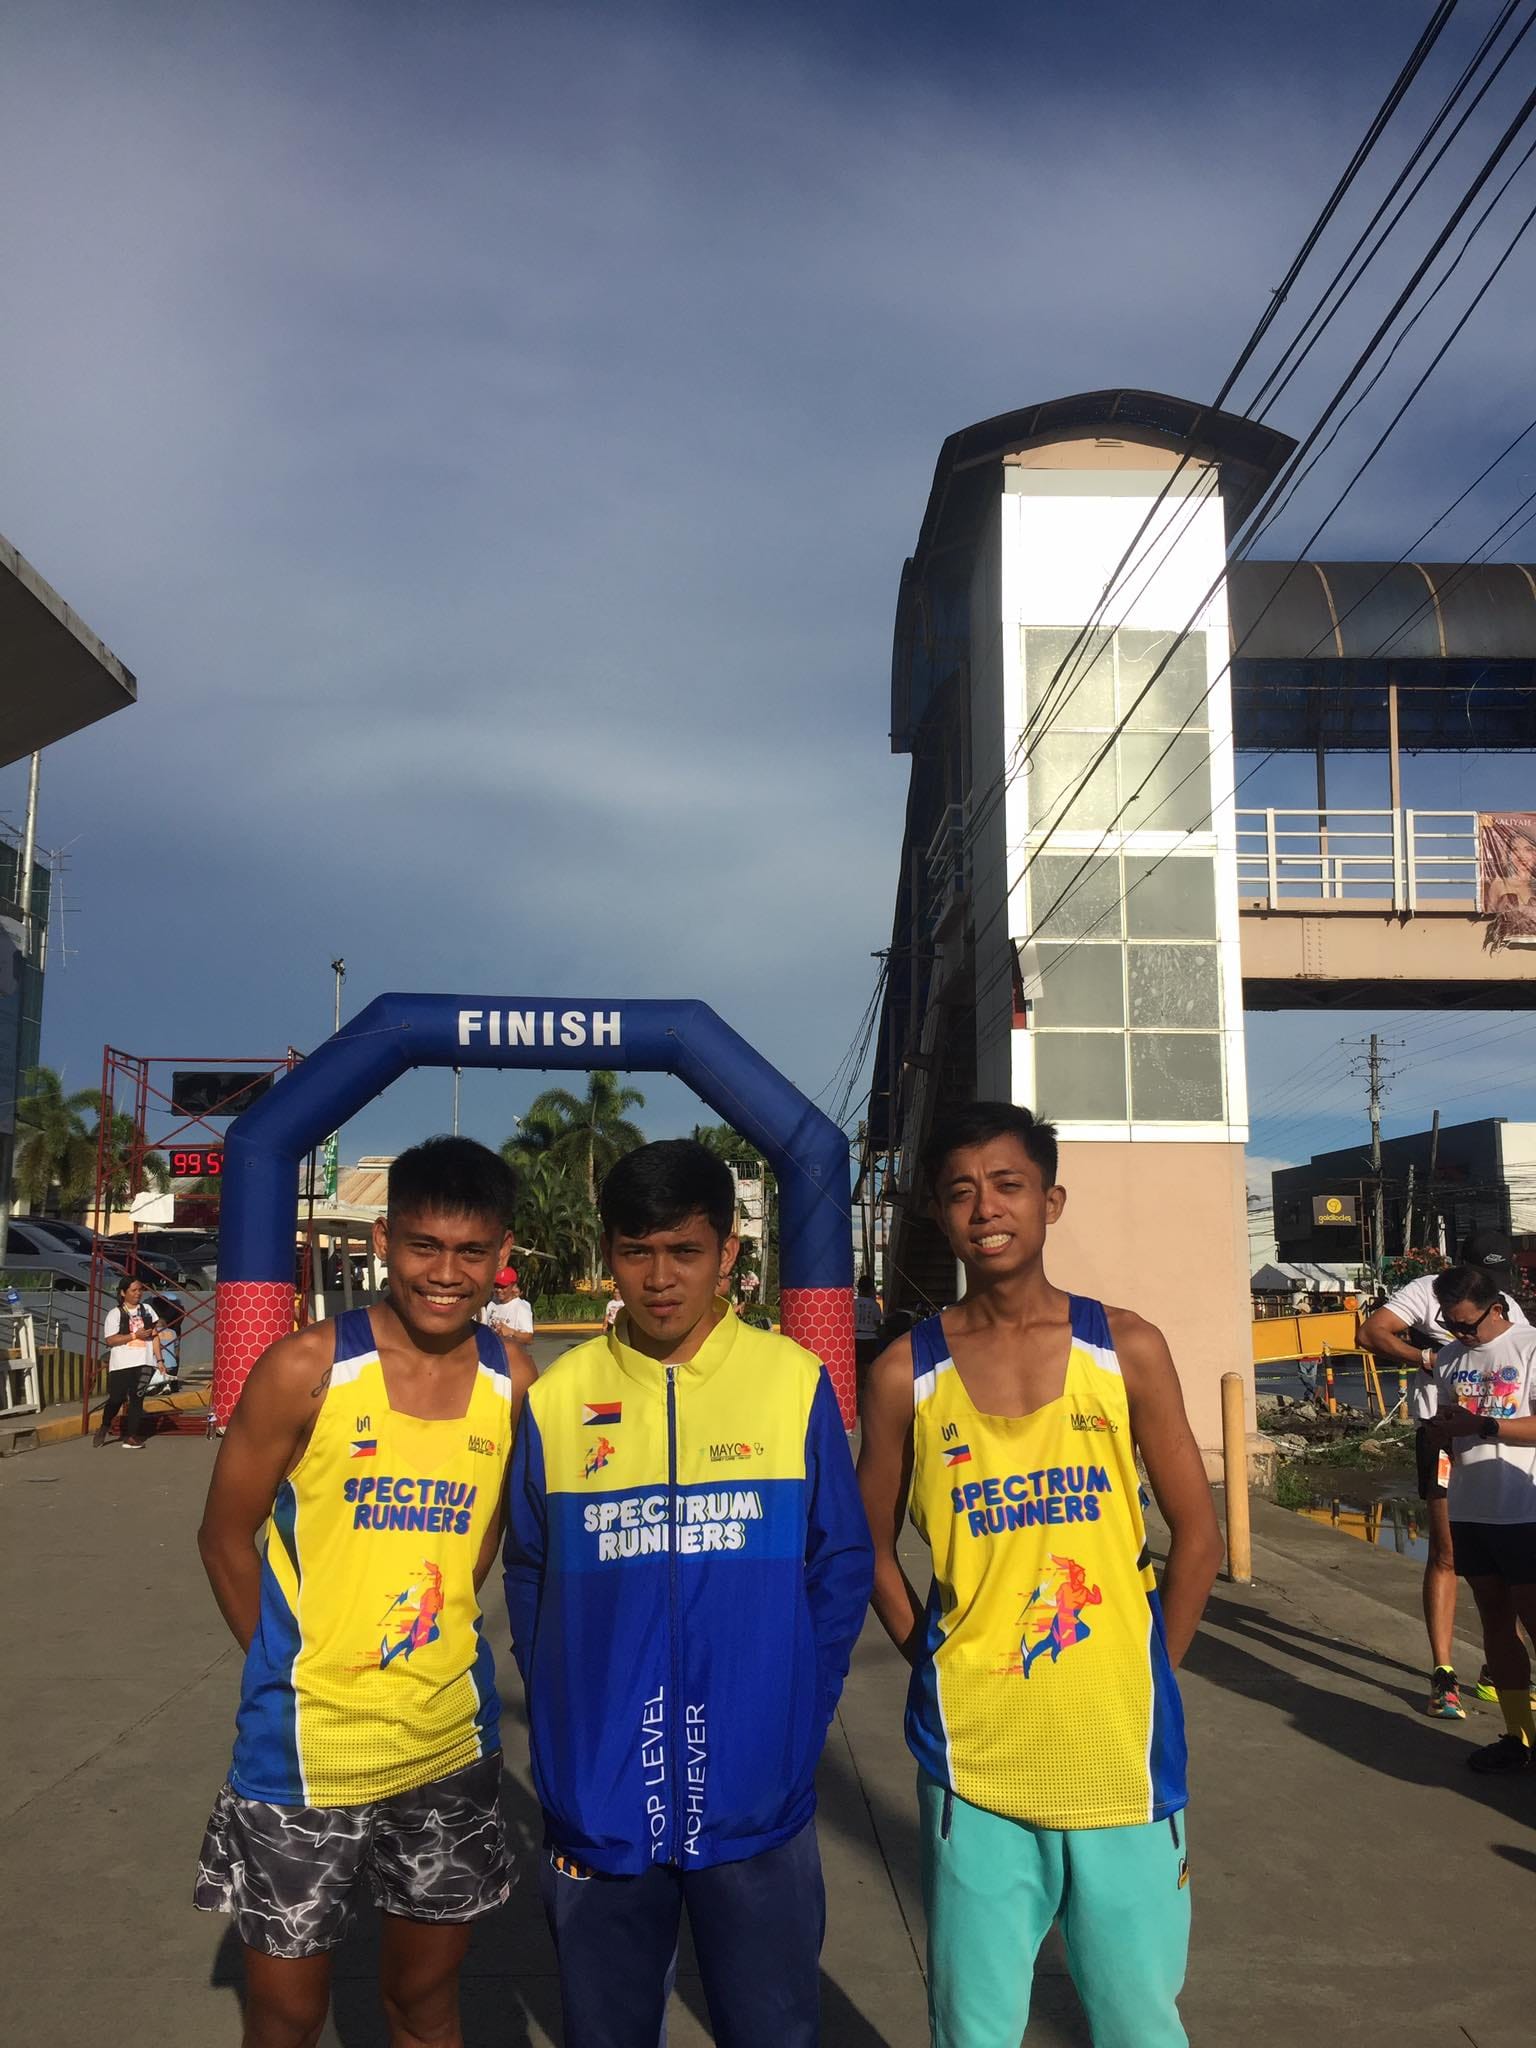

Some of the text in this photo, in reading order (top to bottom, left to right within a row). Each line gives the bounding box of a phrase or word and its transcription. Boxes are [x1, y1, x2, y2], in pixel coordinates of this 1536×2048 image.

[458, 1010, 621, 1046] FINISH
[174, 1152, 225, 1175] 99 5
[951, 1466, 1112, 1513] SPECTRUM
[353, 1504, 471, 1535] RUNNERS
[968, 1494, 1102, 1537] RUNNERS
[642, 1685, 666, 1859] TOP LEVEL
[683, 1703, 707, 1856] ACHIEVER
